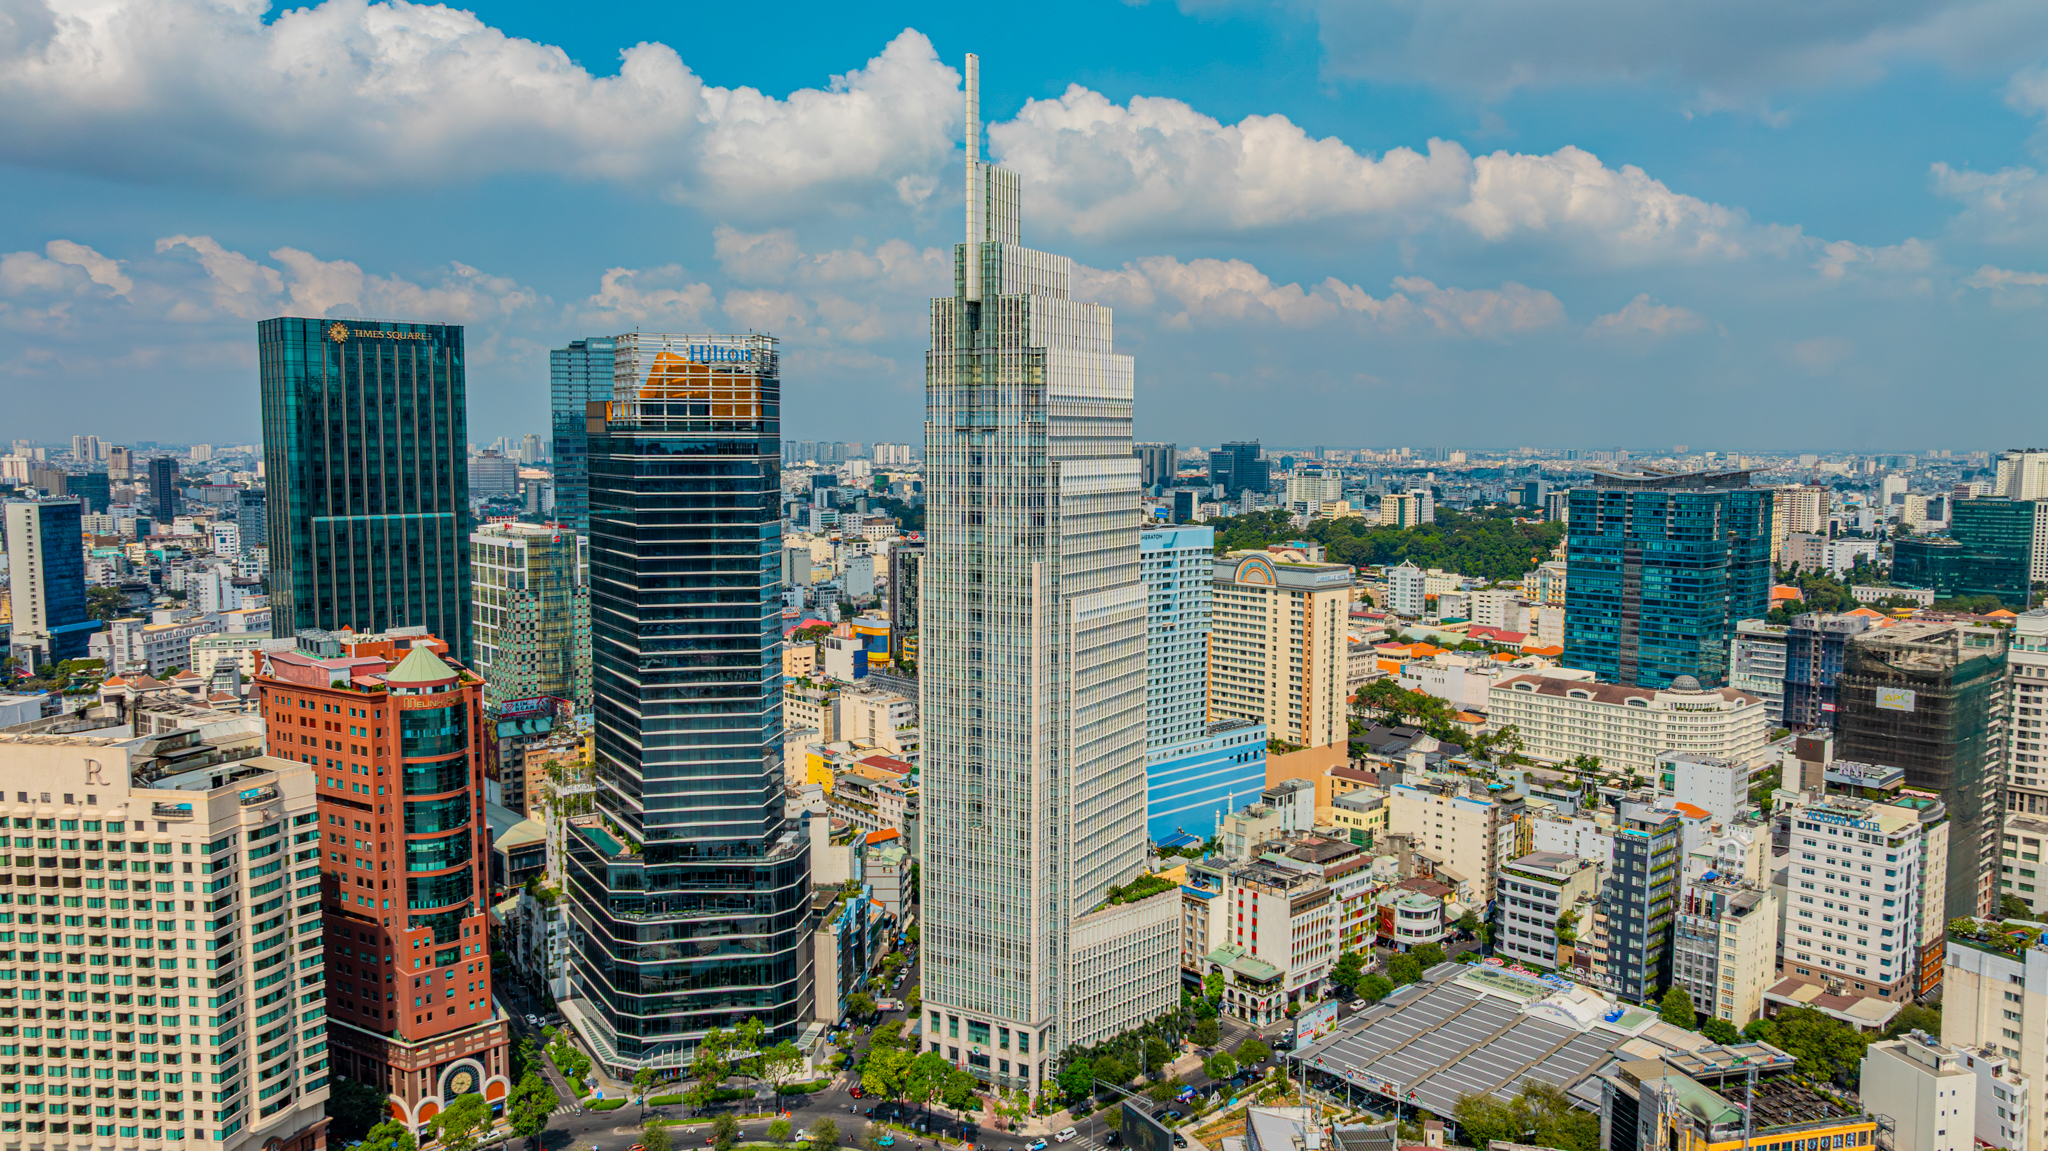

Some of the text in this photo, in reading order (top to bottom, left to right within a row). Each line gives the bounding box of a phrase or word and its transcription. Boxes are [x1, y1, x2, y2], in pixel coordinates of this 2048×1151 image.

[354, 329, 426, 340] TIMES SQUARE
[690, 344, 751, 362] Hilton
[1883, 692, 1912, 703] APC
[84, 758, 110, 786] R
[1849, 818, 1882, 832] HOTEL
